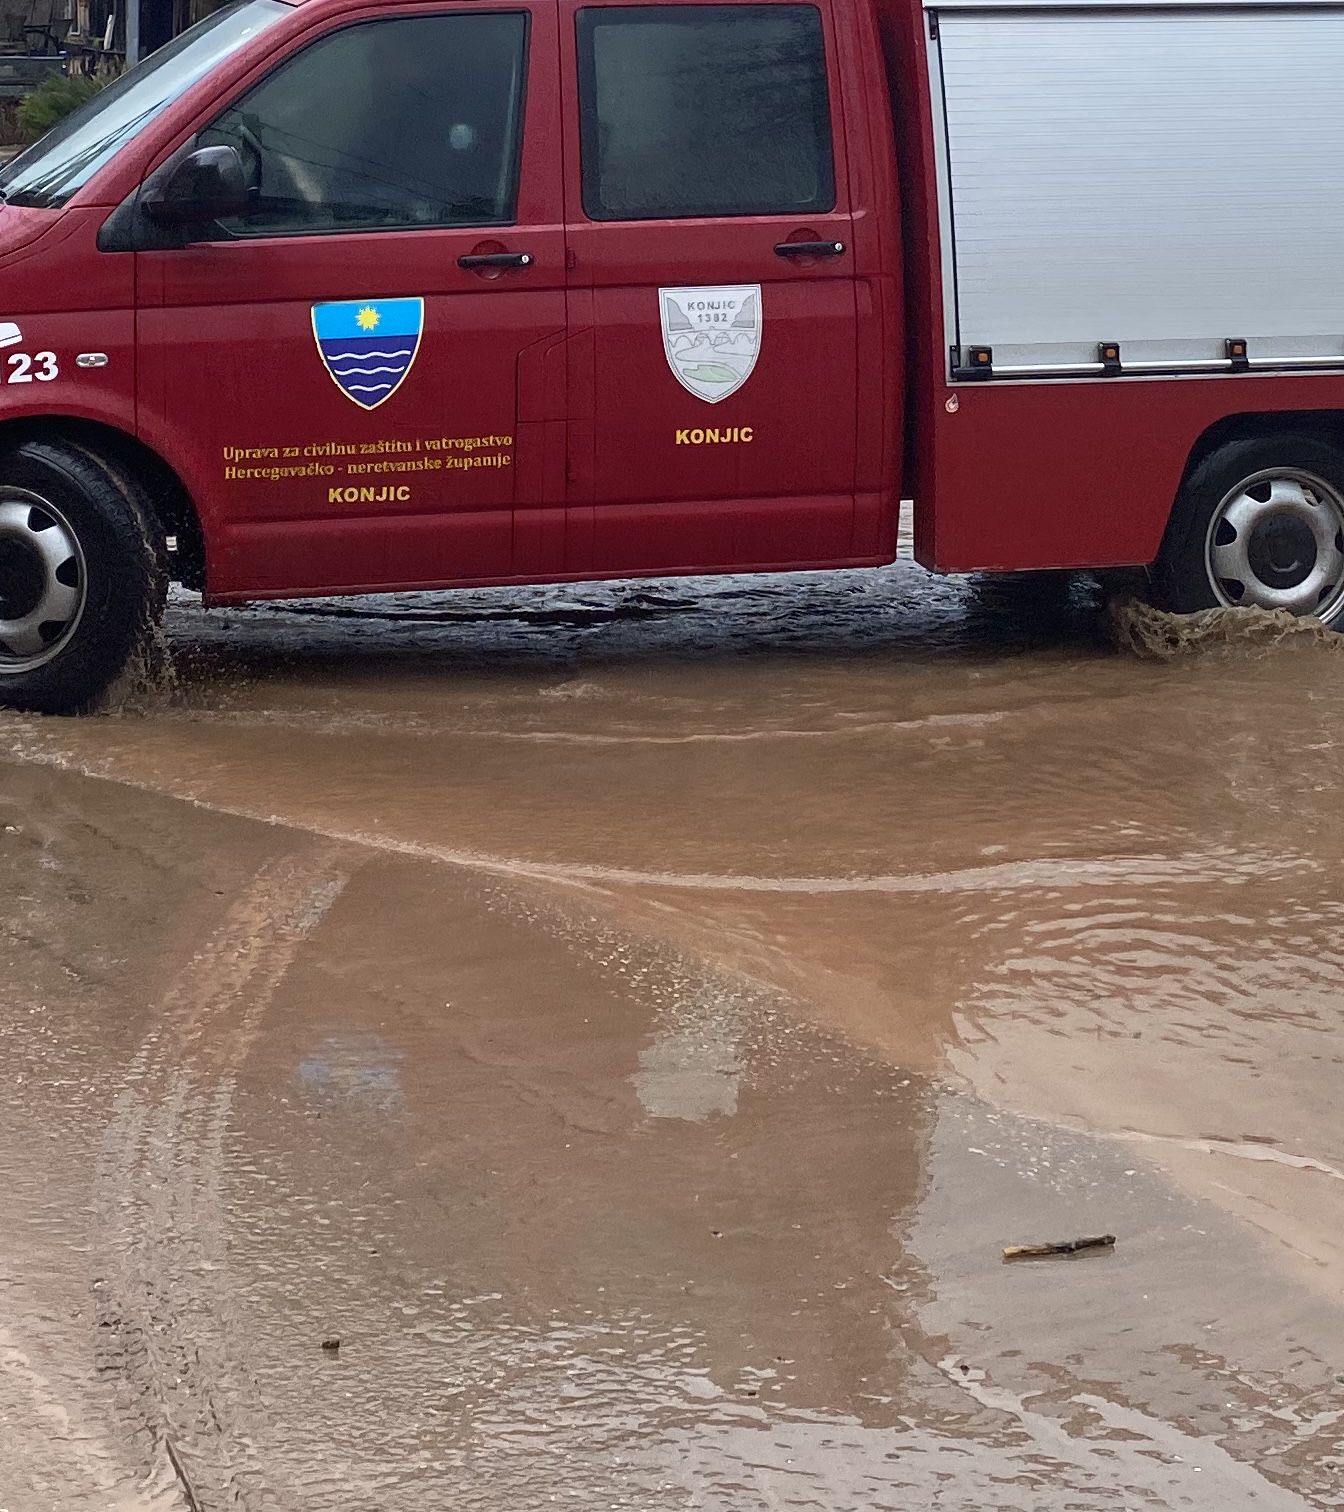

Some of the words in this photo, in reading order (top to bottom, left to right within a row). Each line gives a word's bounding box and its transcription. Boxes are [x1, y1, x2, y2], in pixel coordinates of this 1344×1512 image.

[687, 300, 736, 311] KONJIC
[697, 313, 728, 323] 1382
[675, 427, 754, 445] KONJIC
[223, 446, 279, 462] Uprava
[282, 446, 300, 458] za
[304, 442, 357, 457] civilnu
[359, 439, 413, 455] zaštitu
[415, 439, 421, 452] i
[424, 435, 513, 452] vatrogastvo
[347, 456, 443, 474] neretvanske
[445, 452, 512, 471] županije
[328, 485, 411, 503] KONJIC
